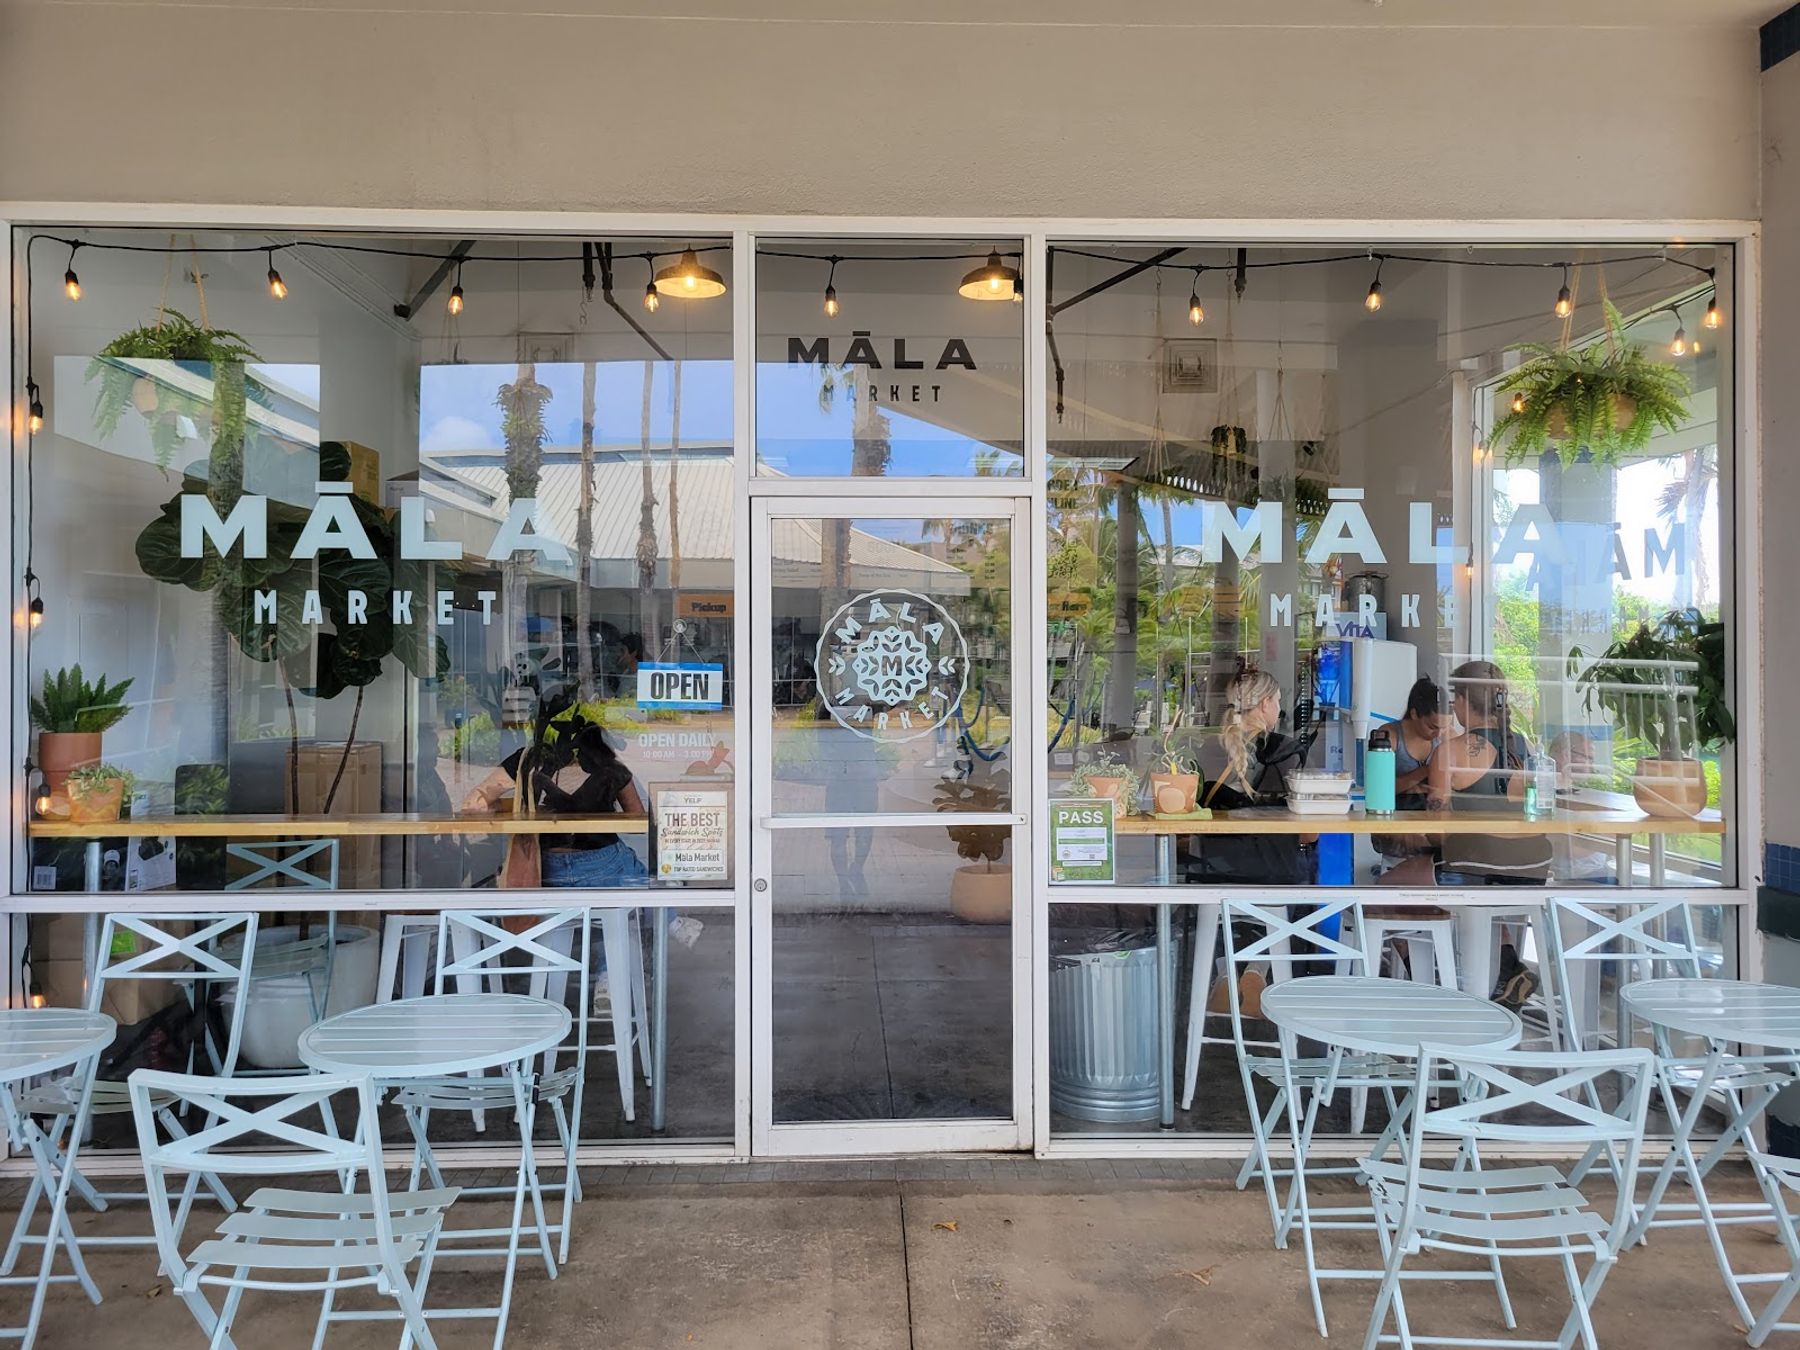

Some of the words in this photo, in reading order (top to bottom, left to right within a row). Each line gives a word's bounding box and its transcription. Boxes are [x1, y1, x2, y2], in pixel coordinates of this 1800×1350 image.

[788, 331, 977, 370] MĀLA
[824, 385, 941, 402] MARKET
[181, 481, 573, 566] MĀLA
[1200, 488, 1563, 564] MĀLA
[254, 590, 496, 625] MARKET
[692, 602, 727, 614] Pickup
[835, 598, 944, 644] MĀLA
[882, 655, 903, 676] M
[651, 672, 709, 700] OPEN
[835, 686, 949, 730] MARKET
[638, 733, 675, 747] OPEN
[679, 733, 715, 747] DAILY
[664, 813, 687, 827] THE
[691, 813, 720, 827] BEST
[1058, 811, 1104, 824] PASS
[660, 827, 699, 837] Sandwich
[694, 853, 720, 862] Market
